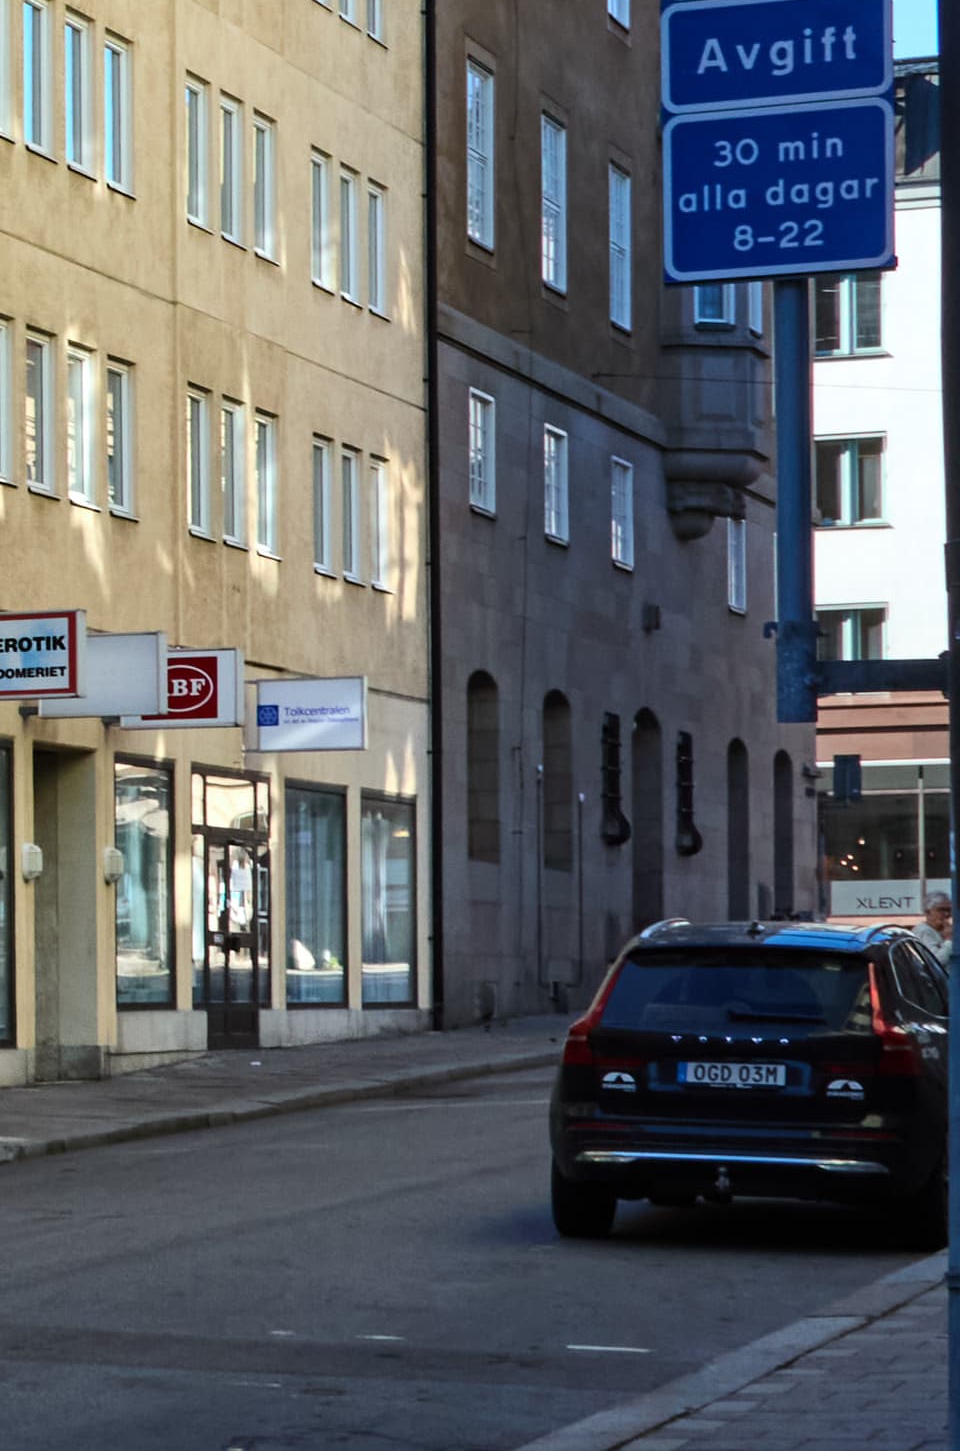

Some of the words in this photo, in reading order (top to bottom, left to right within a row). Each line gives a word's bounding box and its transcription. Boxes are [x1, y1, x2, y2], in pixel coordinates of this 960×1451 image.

[697, 24, 857, 76] Avgift
[713, 138, 759, 167] 30
[778, 132, 844, 163] min
[678, 184, 747, 213] alla
[765, 175, 879, 210] dagar
[732, 219, 825, 252] 8-22
[168, 678, 206, 697] BF
[856, 896, 915, 909] XLENT
[693, 1064, 732, 1082] OGD
